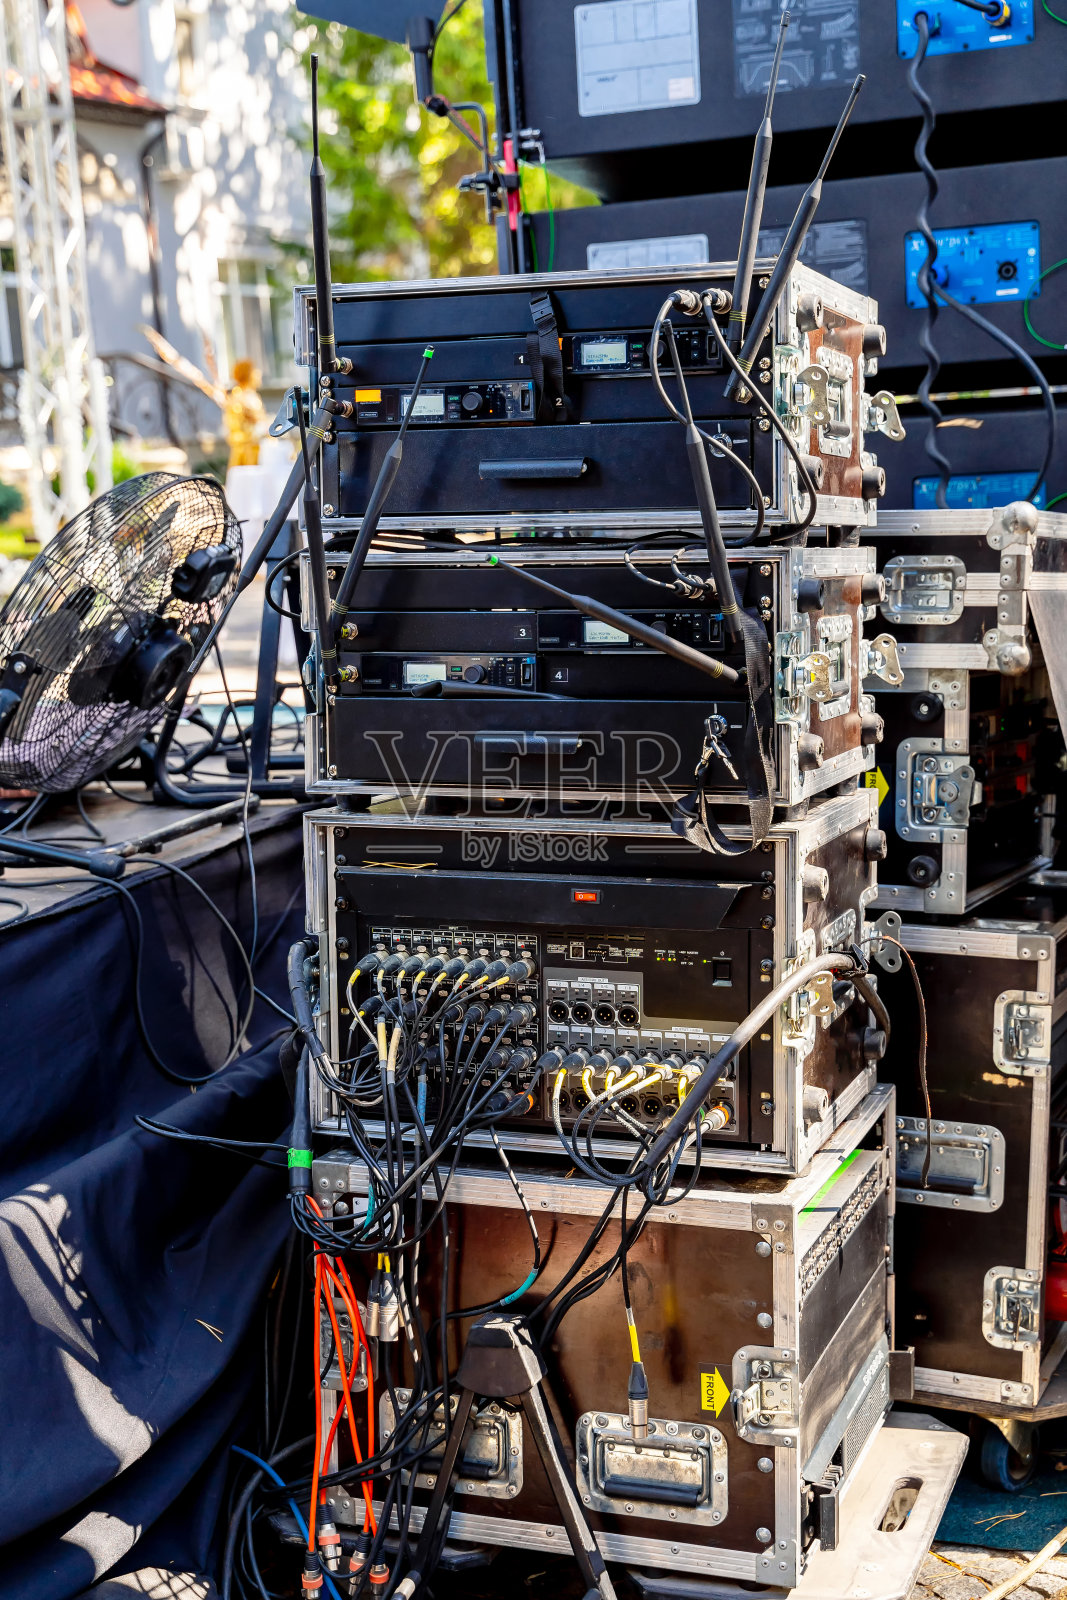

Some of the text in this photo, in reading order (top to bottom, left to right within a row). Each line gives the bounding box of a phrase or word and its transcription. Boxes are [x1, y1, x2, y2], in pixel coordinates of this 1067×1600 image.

[518, 355, 524, 364] 1
[556, 398, 563, 406] 2
[519, 628, 526, 637] 3
[555, 671, 563, 680] 4
[706, 1375, 714, 1410] FRONT
